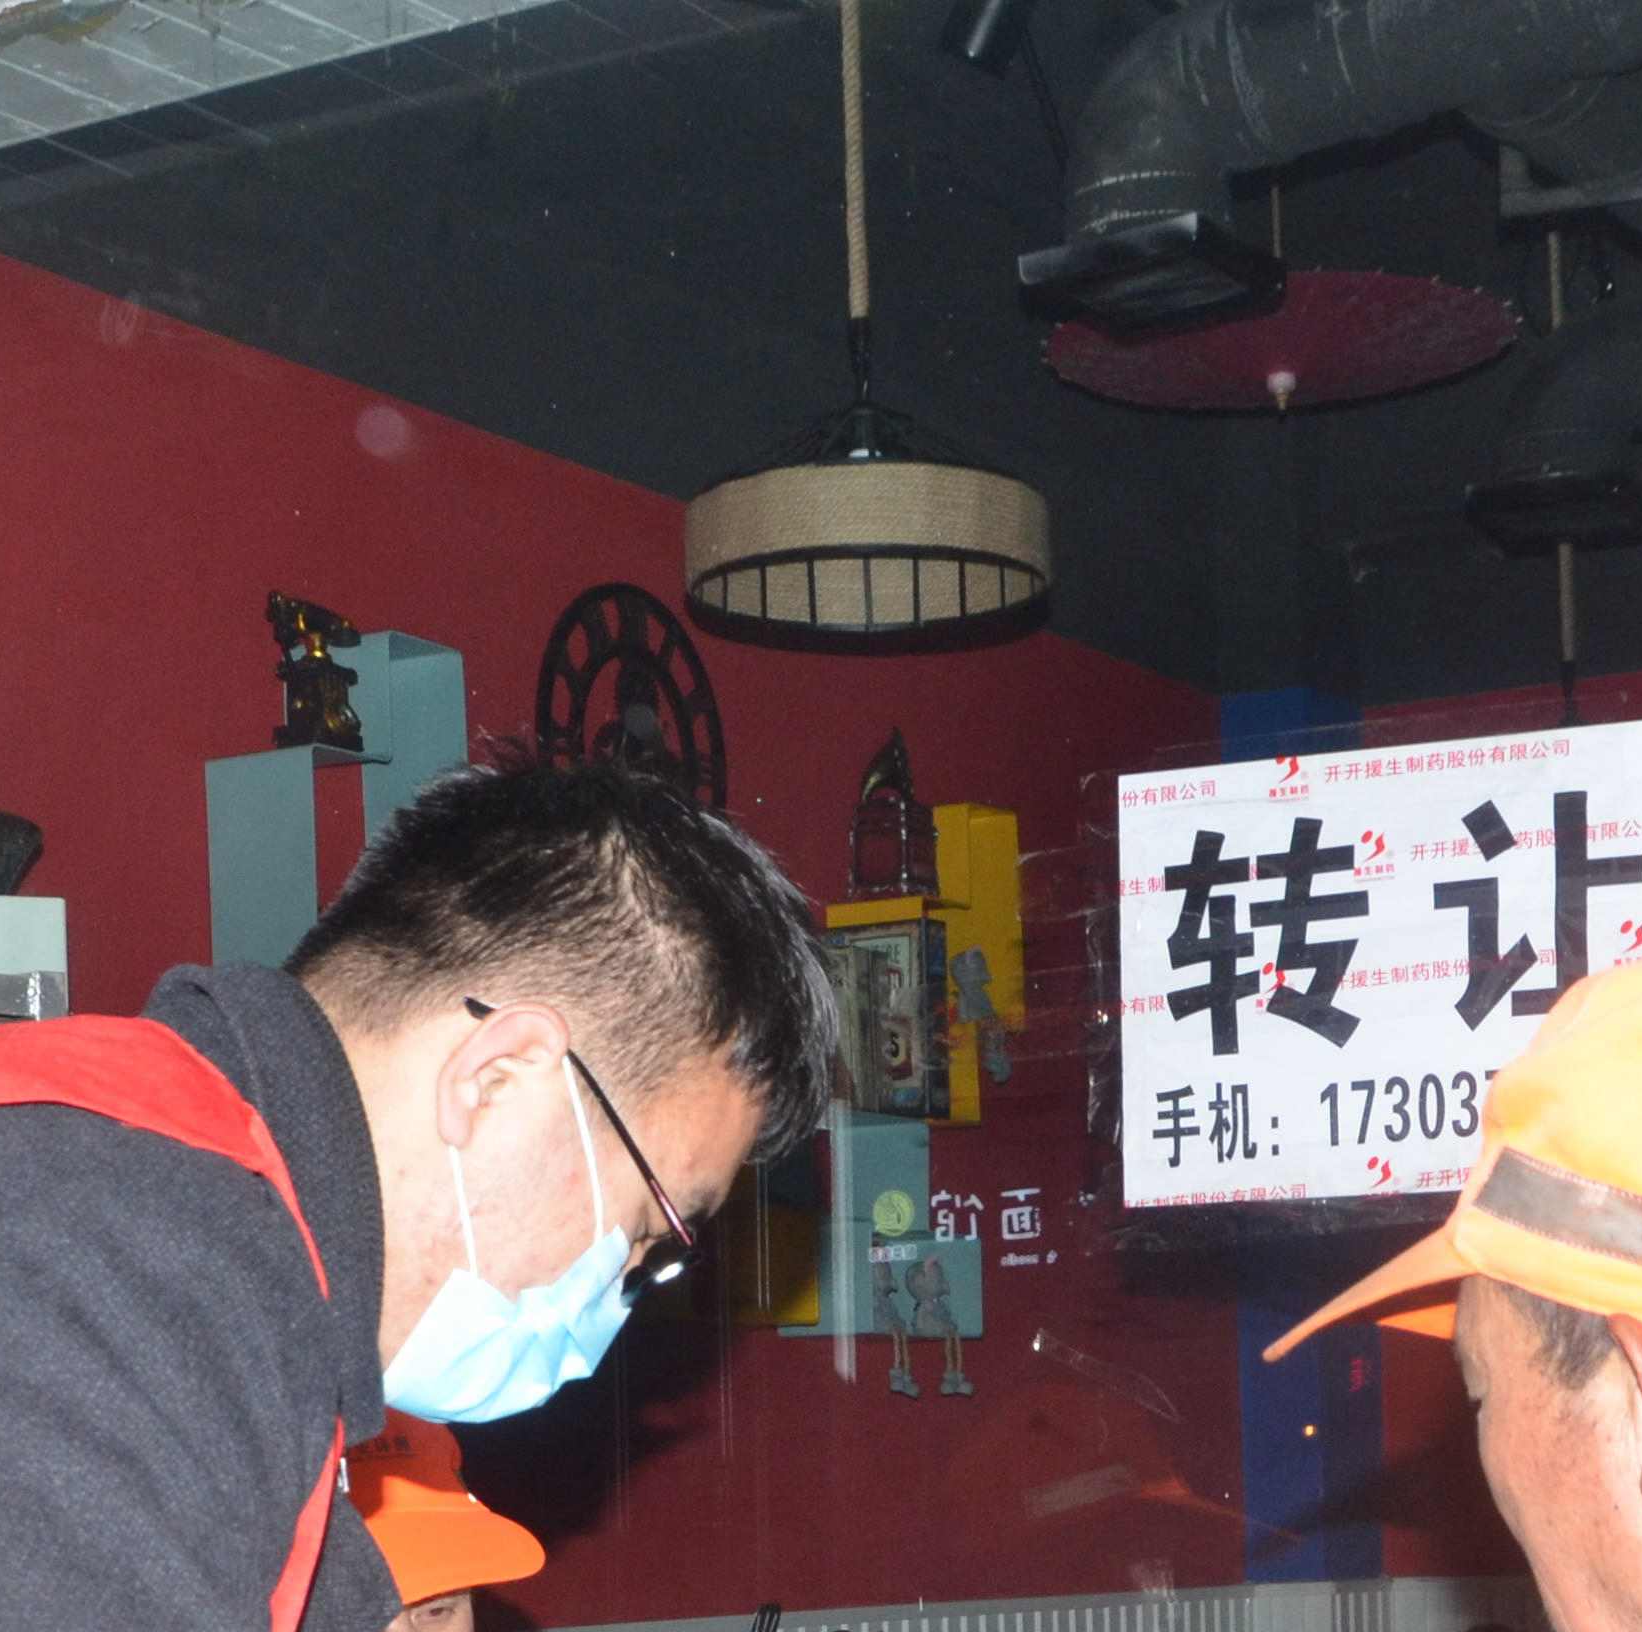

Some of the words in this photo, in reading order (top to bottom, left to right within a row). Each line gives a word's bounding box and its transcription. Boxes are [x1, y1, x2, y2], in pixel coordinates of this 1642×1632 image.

[1324, 739, 1571, 783] 开开援生制药股份有限公司
